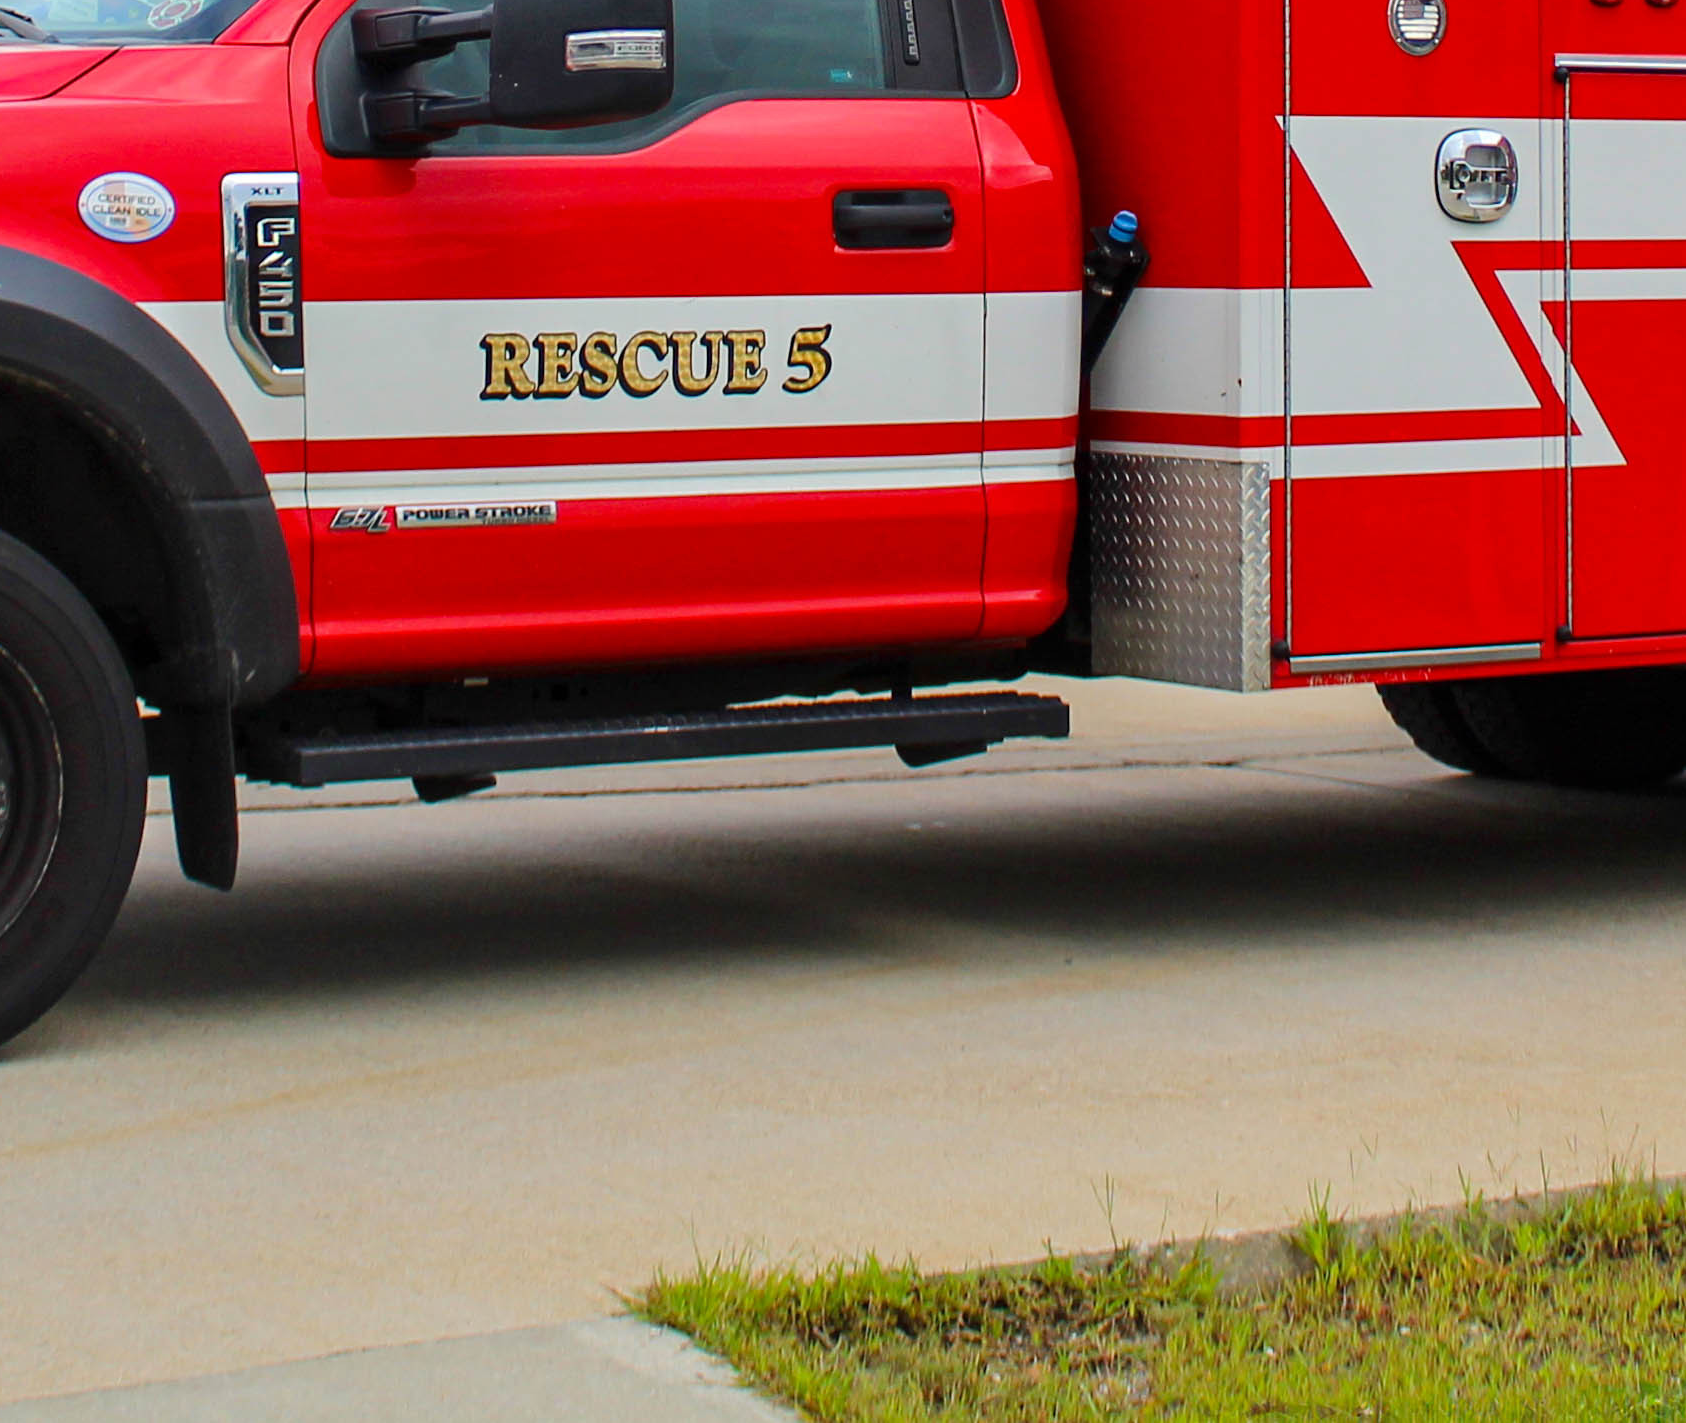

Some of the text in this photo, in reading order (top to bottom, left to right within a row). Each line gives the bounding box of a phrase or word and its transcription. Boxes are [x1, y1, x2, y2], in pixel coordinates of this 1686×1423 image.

[251, 187, 284, 195] XLT
[98, 193, 156, 205] CERTIFIED
[92, 204, 161, 218] CLEAN IDLE
[479, 324, 833, 400] RESCUE 5
[403, 507, 469, 522] POWER
[475, 504, 552, 519] STROKE
